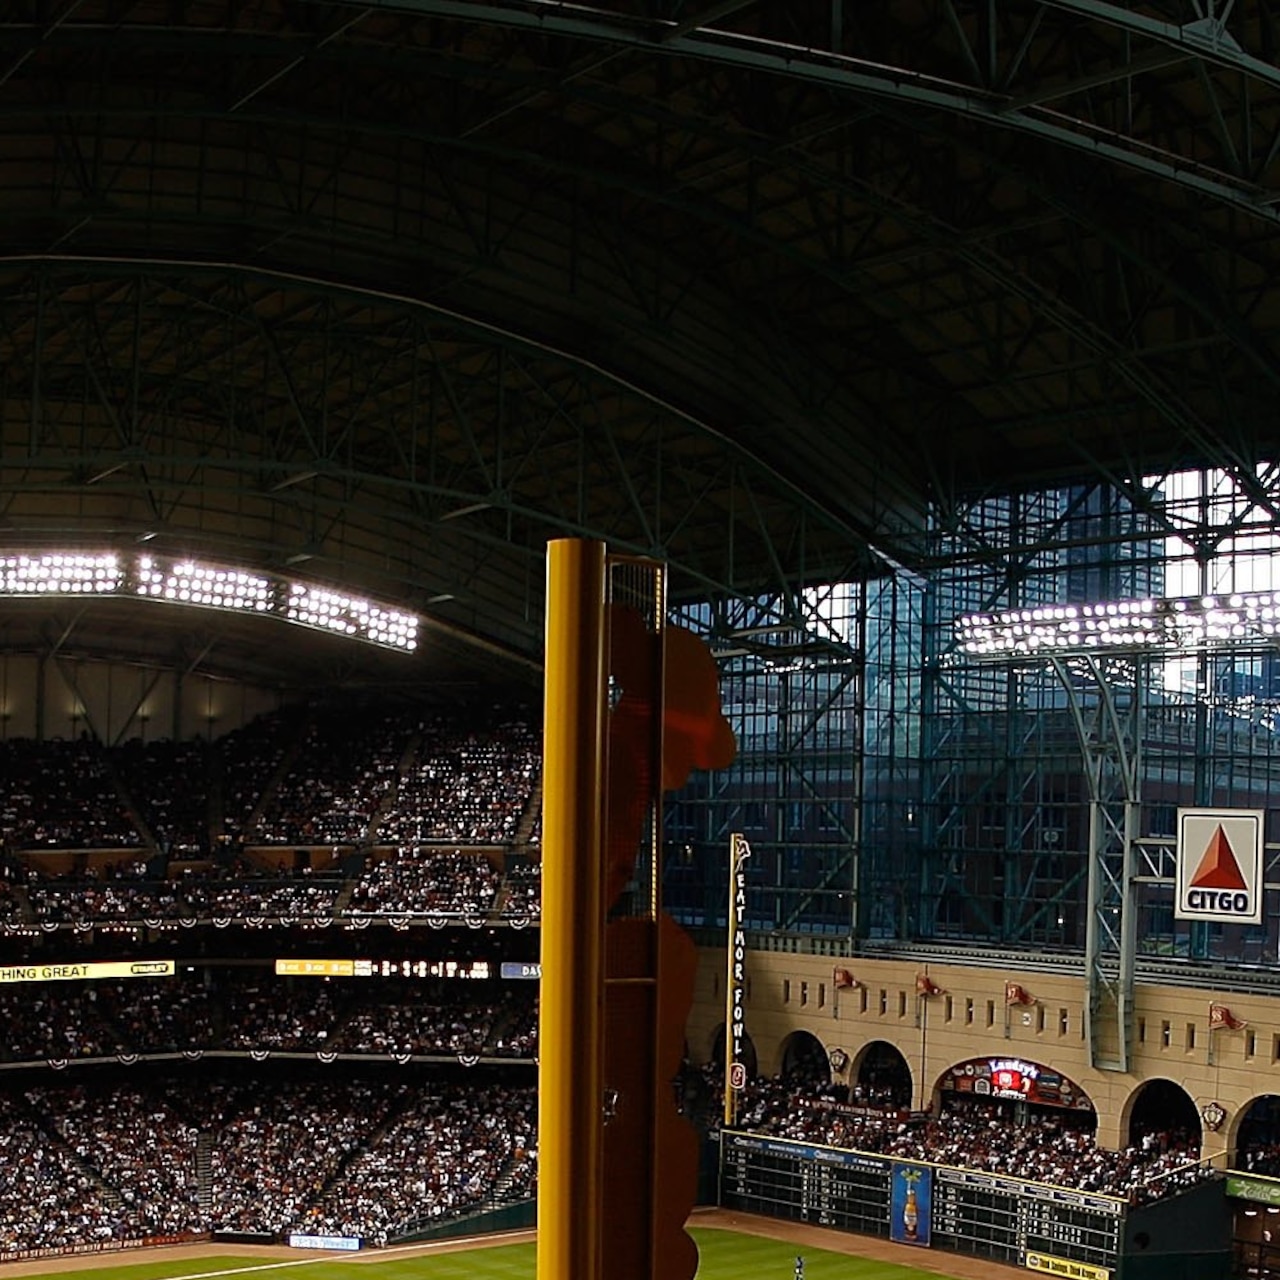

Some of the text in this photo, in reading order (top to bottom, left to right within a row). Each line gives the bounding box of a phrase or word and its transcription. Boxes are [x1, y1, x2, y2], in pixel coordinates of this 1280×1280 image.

[1188, 890, 1248, 912] CITGO
[41, 965, 89, 979] GREAT
[733, 874, 746, 1055] EAT MOR FOWL
